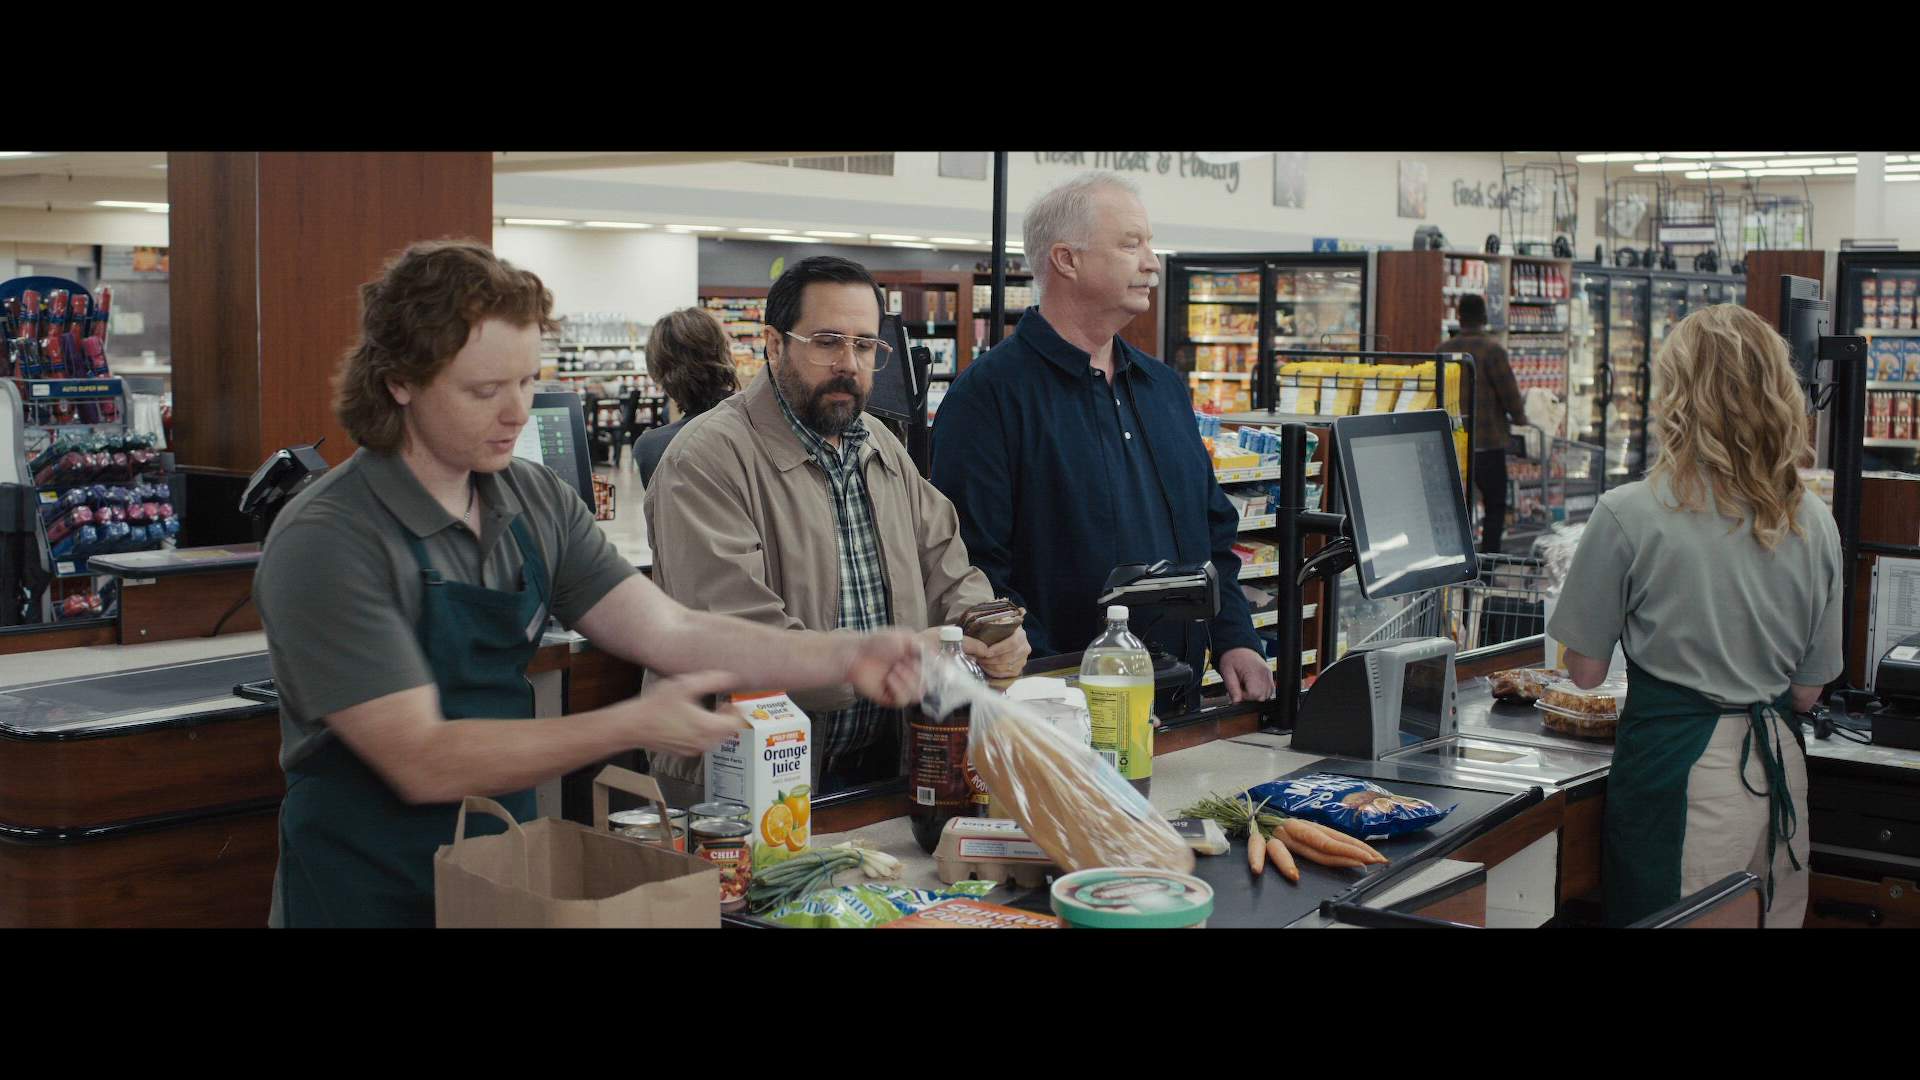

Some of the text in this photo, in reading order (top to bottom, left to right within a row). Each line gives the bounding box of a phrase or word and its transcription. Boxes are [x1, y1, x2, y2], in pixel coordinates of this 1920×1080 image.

[1094, 152, 1150, 172] Meat
[764, 744, 808, 761] Orange
[772, 760, 801, 777] Juice
[710, 850, 740, 859] CHILI
[918, 911, 1025, 928] Cooki
[946, 904, 1059, 928] Sandwi
